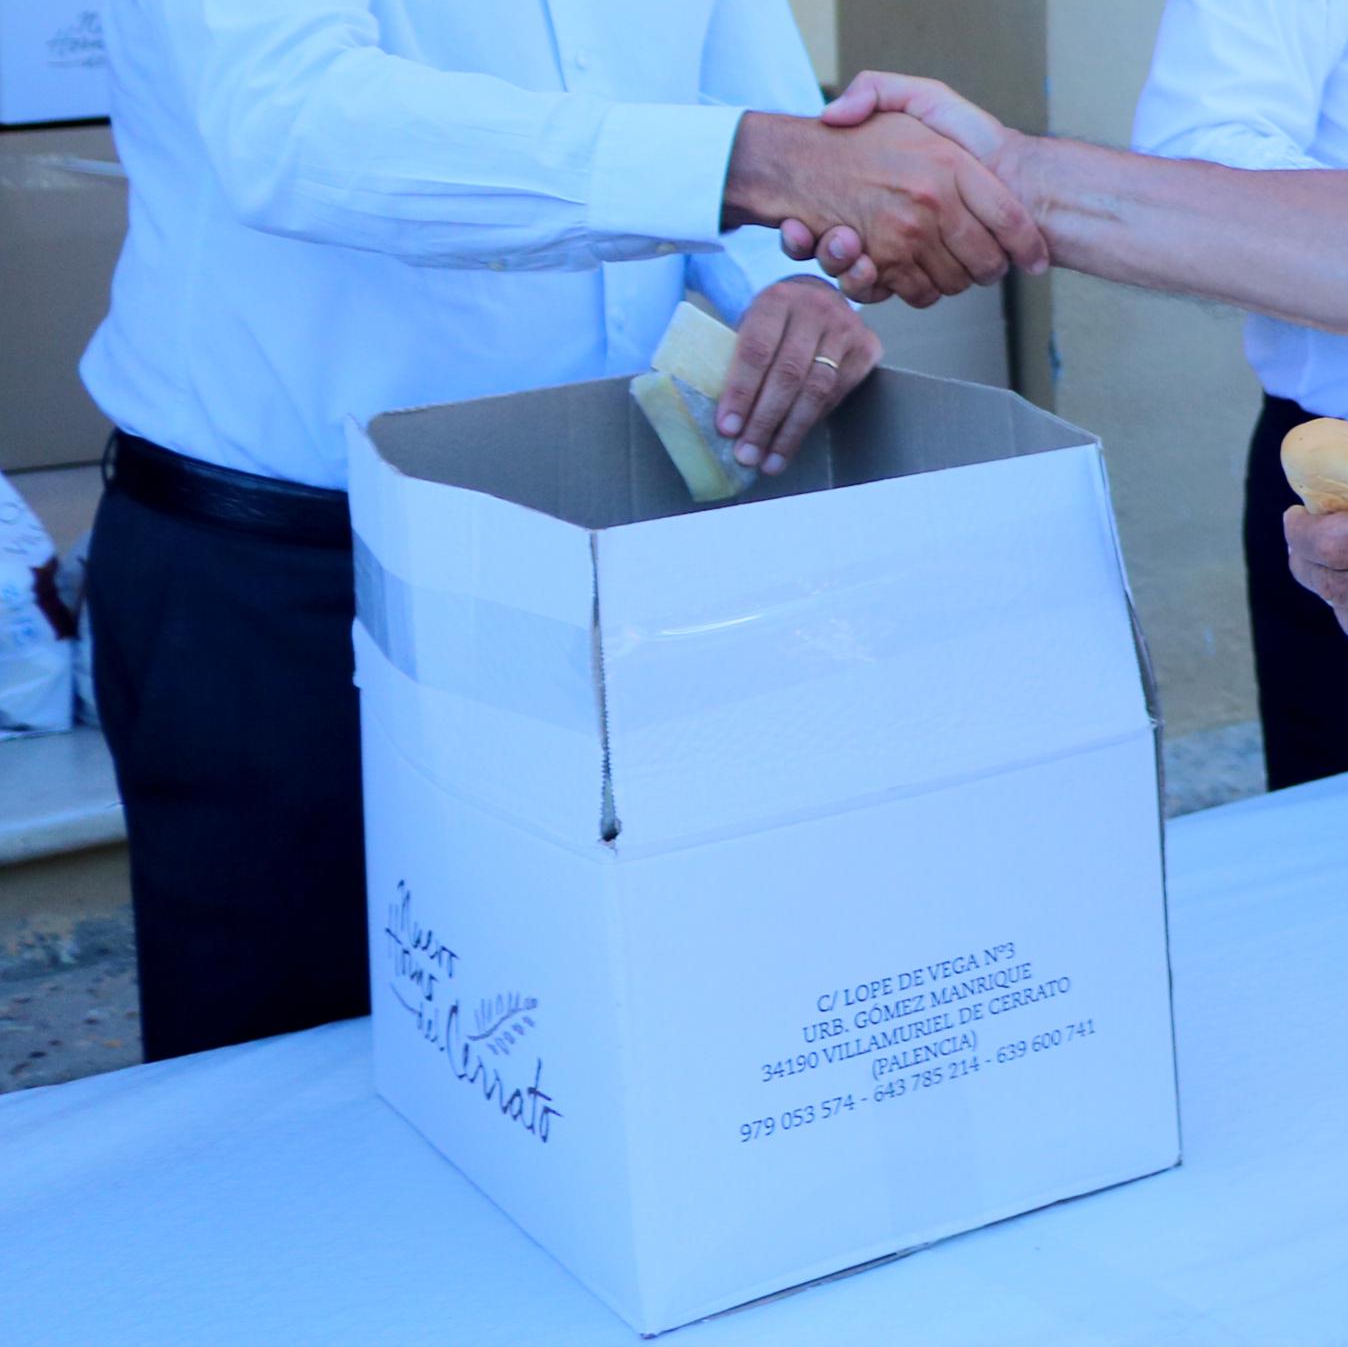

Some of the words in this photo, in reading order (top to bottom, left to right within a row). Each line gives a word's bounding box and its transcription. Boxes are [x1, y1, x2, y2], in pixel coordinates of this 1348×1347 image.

[761, 1051, 819, 1082] 34190
[822, 1012, 954, 1065] VILLAMURIEL
[958, 1003, 984, 1025] DE
[988, 977, 1071, 1016] CERRATO
[802, 1018, 845, 1045] URB.
[853, 994, 926, 1030] GÓMEZ
[930, 962, 1033, 1005] MANRIQUE
[816, 990, 838, 1013] C/
[843, 977, 893, 1006] LOPE
[898, 969, 925, 991] DE
[927, 953, 980, 981] VEGA
[446, 999, 565, 1143] Cerrato
[739, 1116, 776, 1143] 979
[781, 1105, 816, 1131] 053
[820, 1093, 855, 1119] 574
[873, 1078, 906, 1103] 643
[911, 1067, 943, 1092] 785
[949, 1055, 981, 1081] 214
[996, 1040, 1028, 1064] 639
[1031, 1028, 1063, 1053] 600
[1066, 1018, 1096, 1042] 741
[871, 1029, 979, 1081] (PALENCIA)
